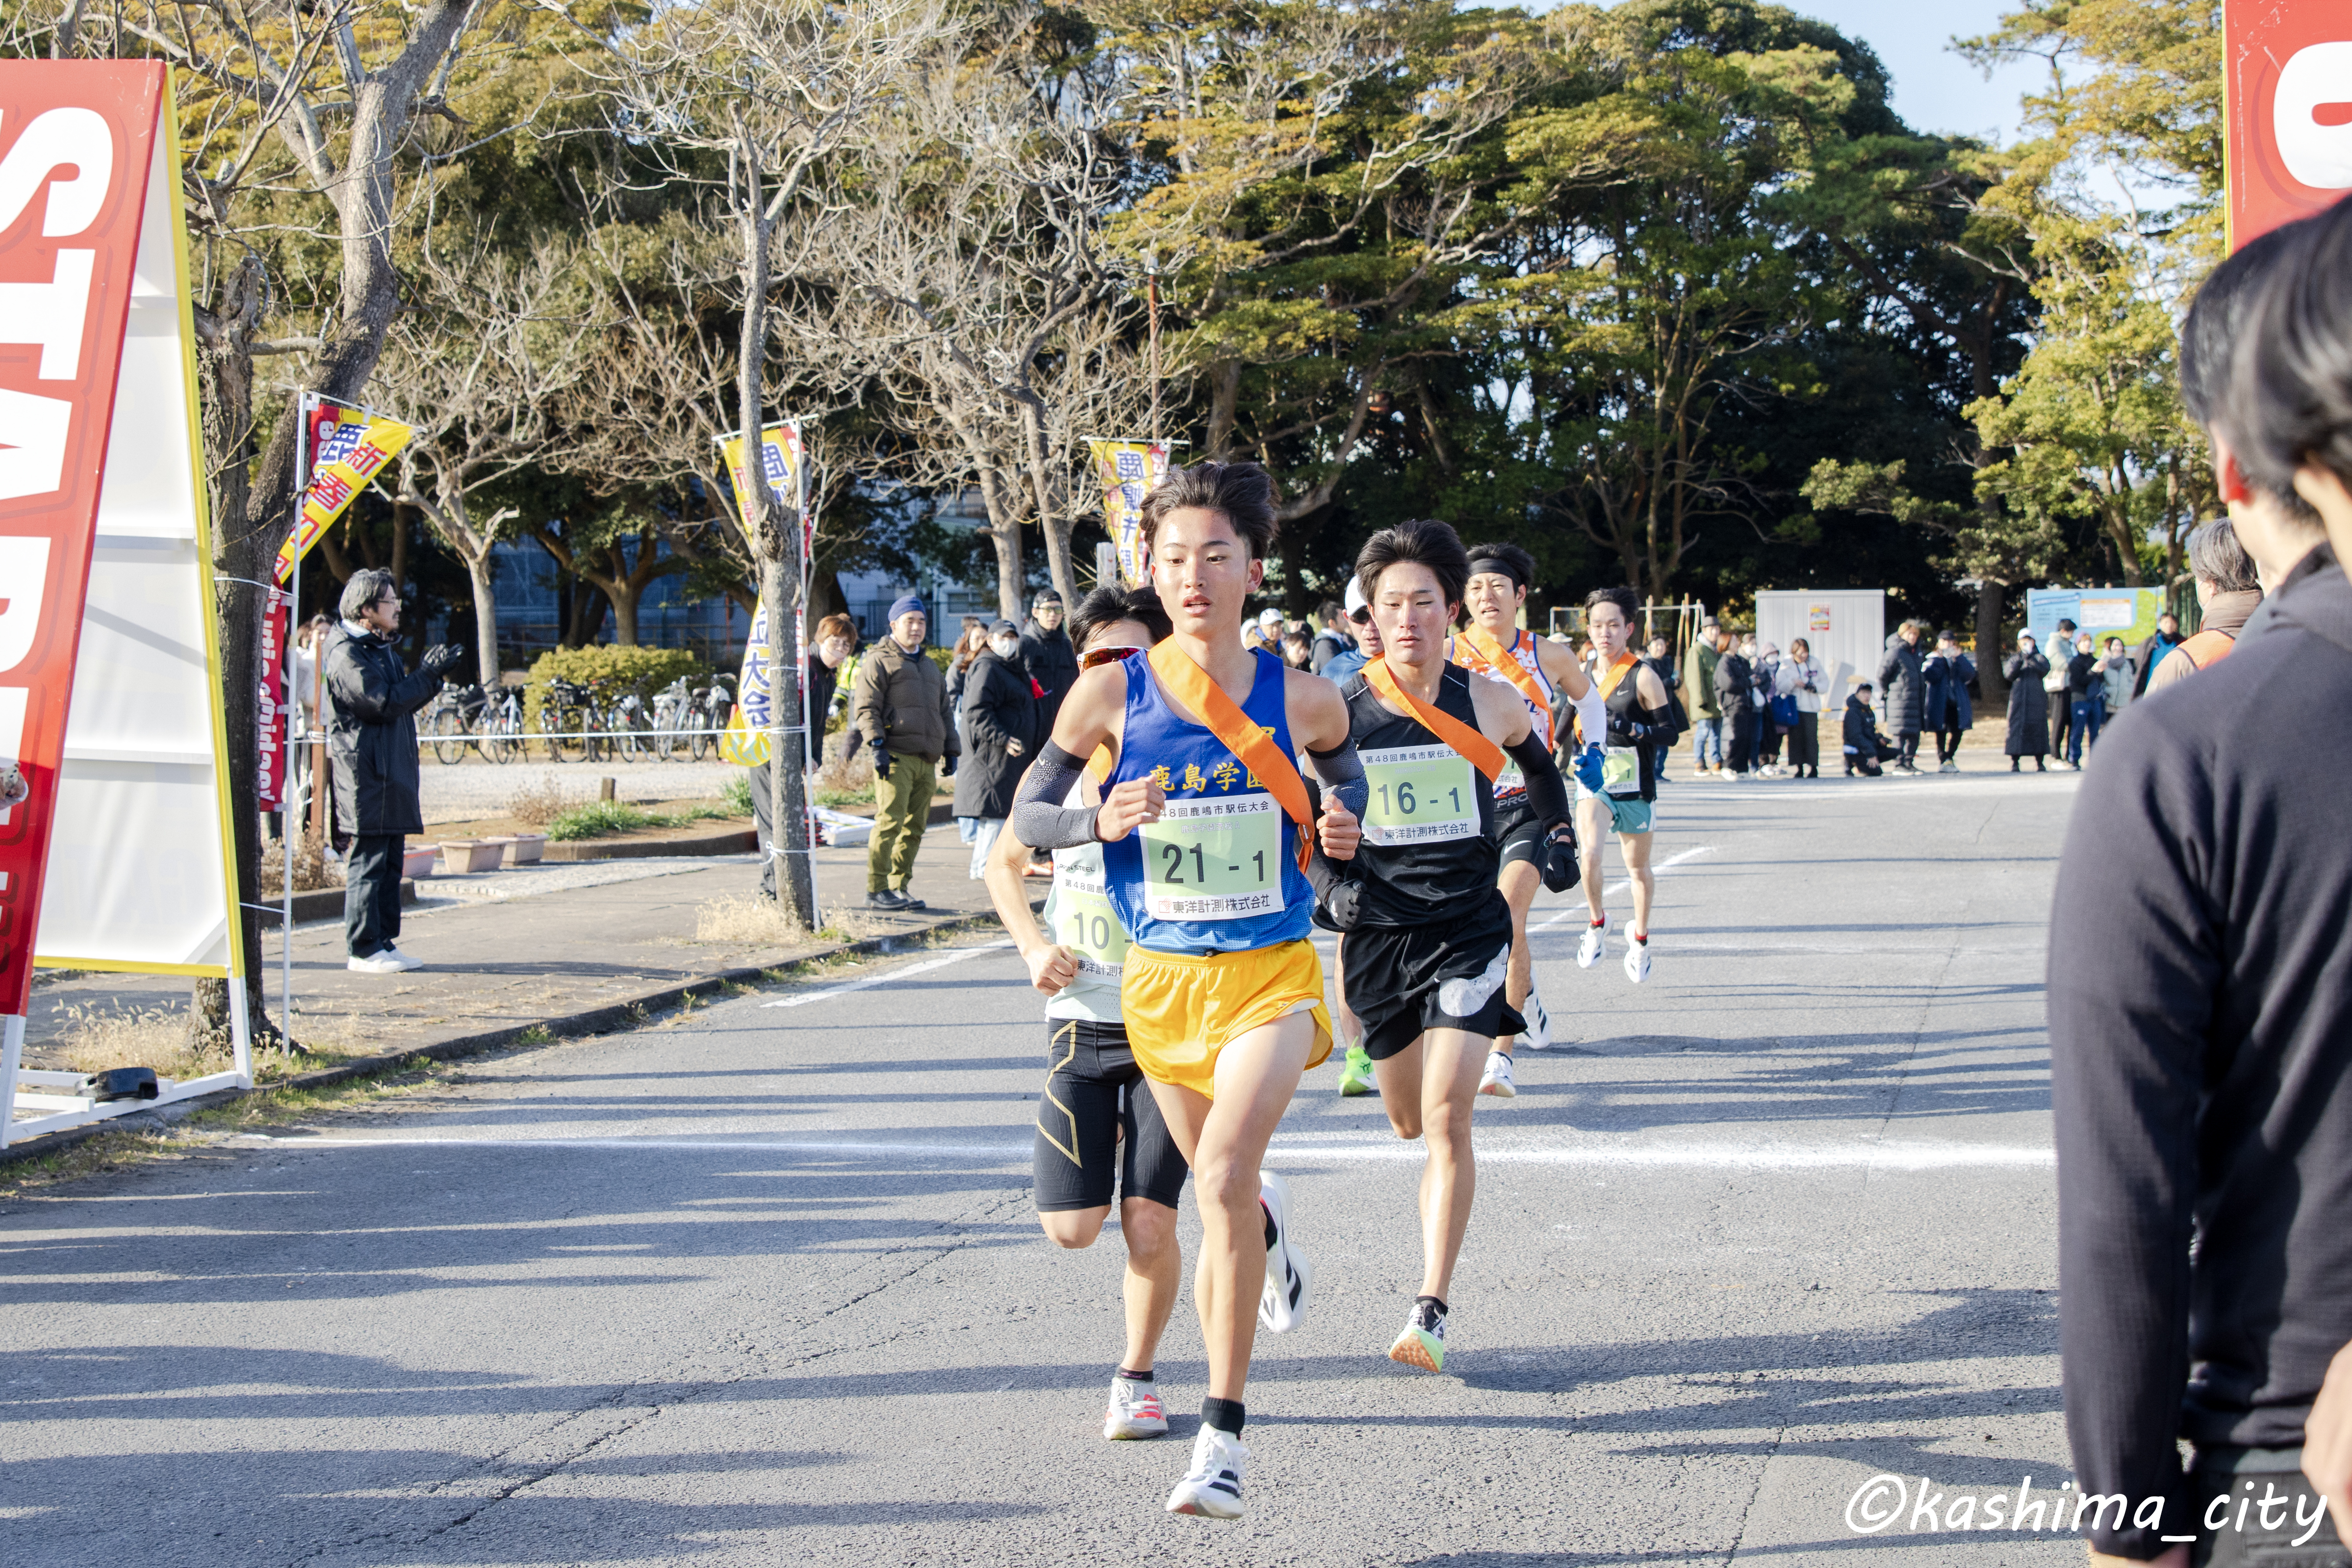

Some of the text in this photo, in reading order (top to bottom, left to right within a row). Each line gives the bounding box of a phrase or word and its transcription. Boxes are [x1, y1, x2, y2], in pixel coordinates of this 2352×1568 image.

[1626, 769, 1630, 779] 1
[1377, 782, 1416, 816] 16
[1448, 787, 1460, 813] 1
[1159, 800, 1269, 818] 48回鹿嶋市駅伝大会
[1234, 821, 1241, 829] A
[1384, 823, 1469, 840] 東洋計測株式会社
[1162, 843, 1204, 884] 21
[1253, 850, 1264, 882] 1
[1081, 897, 1112, 908] 日本製鉄
[1173, 894, 1270, 913] 東洋計測株式会社
[1074, 912, 1109, 950] 10
